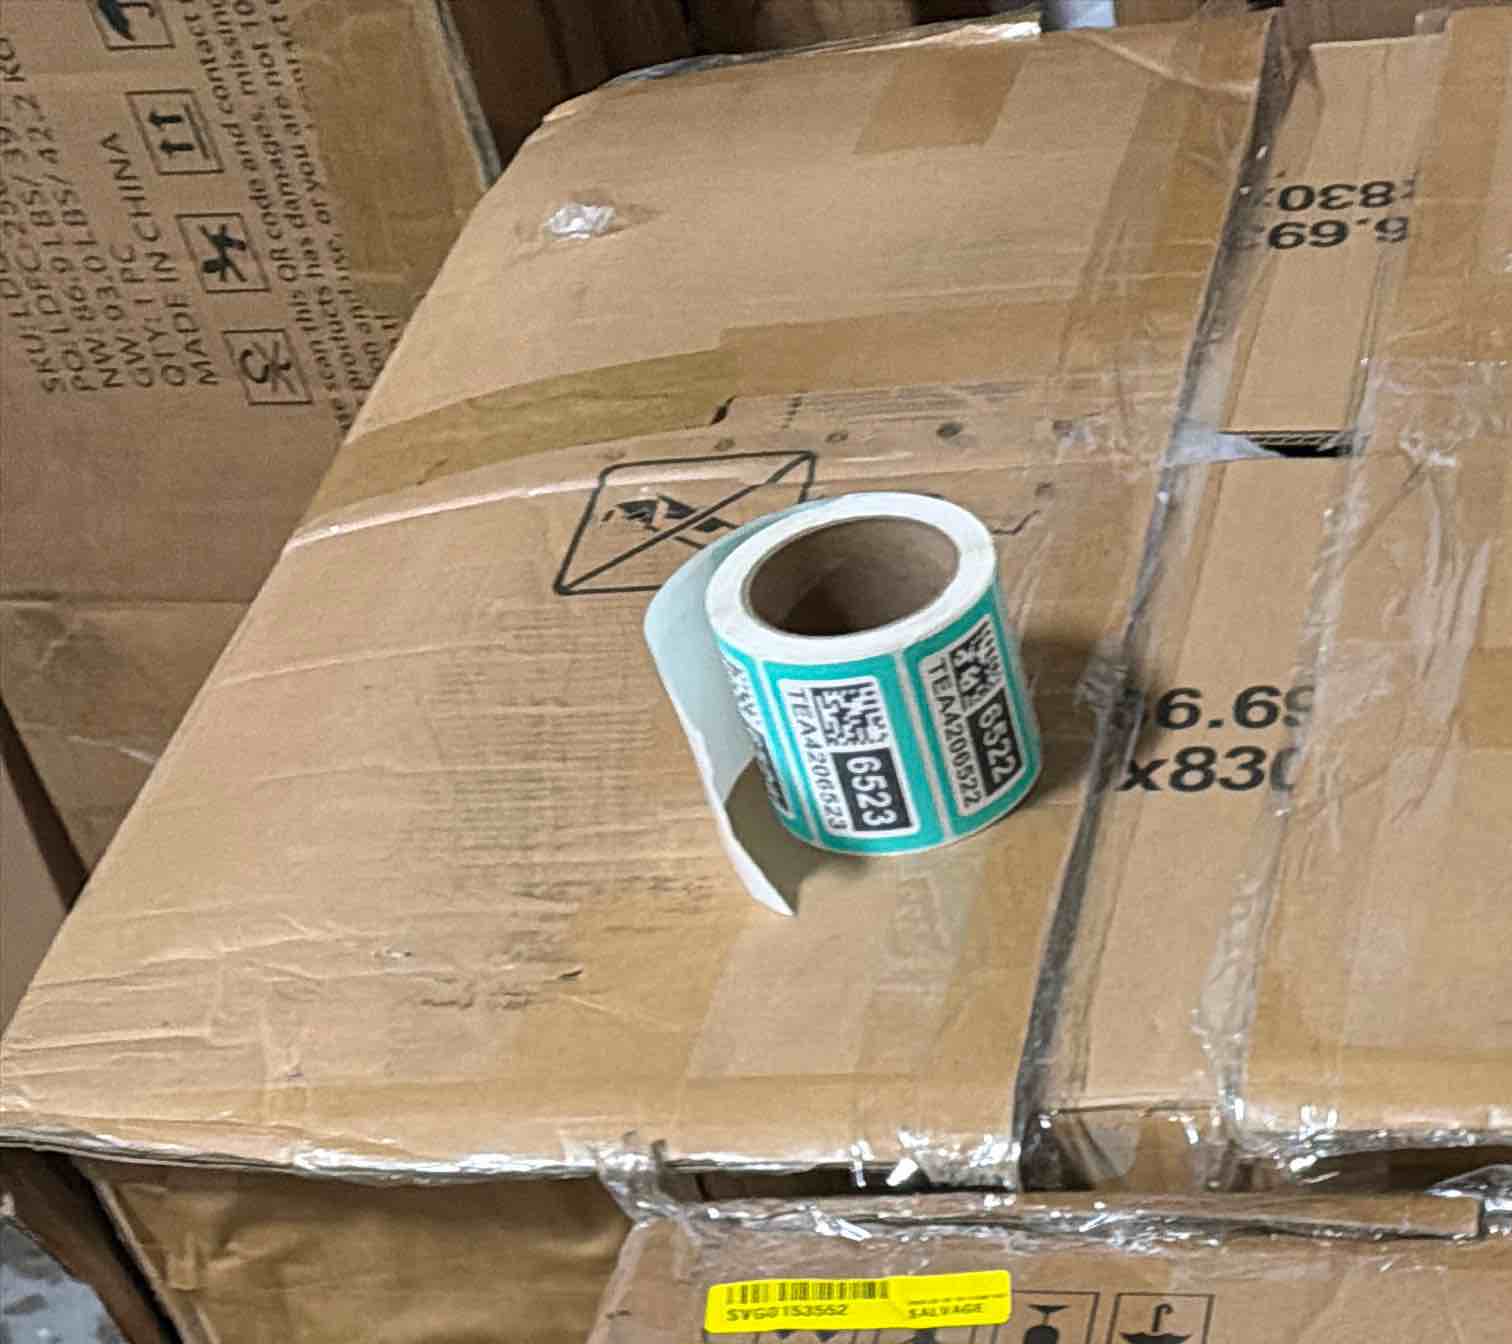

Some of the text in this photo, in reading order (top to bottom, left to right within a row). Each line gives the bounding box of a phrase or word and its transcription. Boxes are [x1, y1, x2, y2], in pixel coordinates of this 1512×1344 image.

[100, 134, 219, 386] MADE IN CHINA
[106, 241, 147, 284] PC
[980, 696, 1022, 782] 6522
[849, 755, 895, 830] 6523
